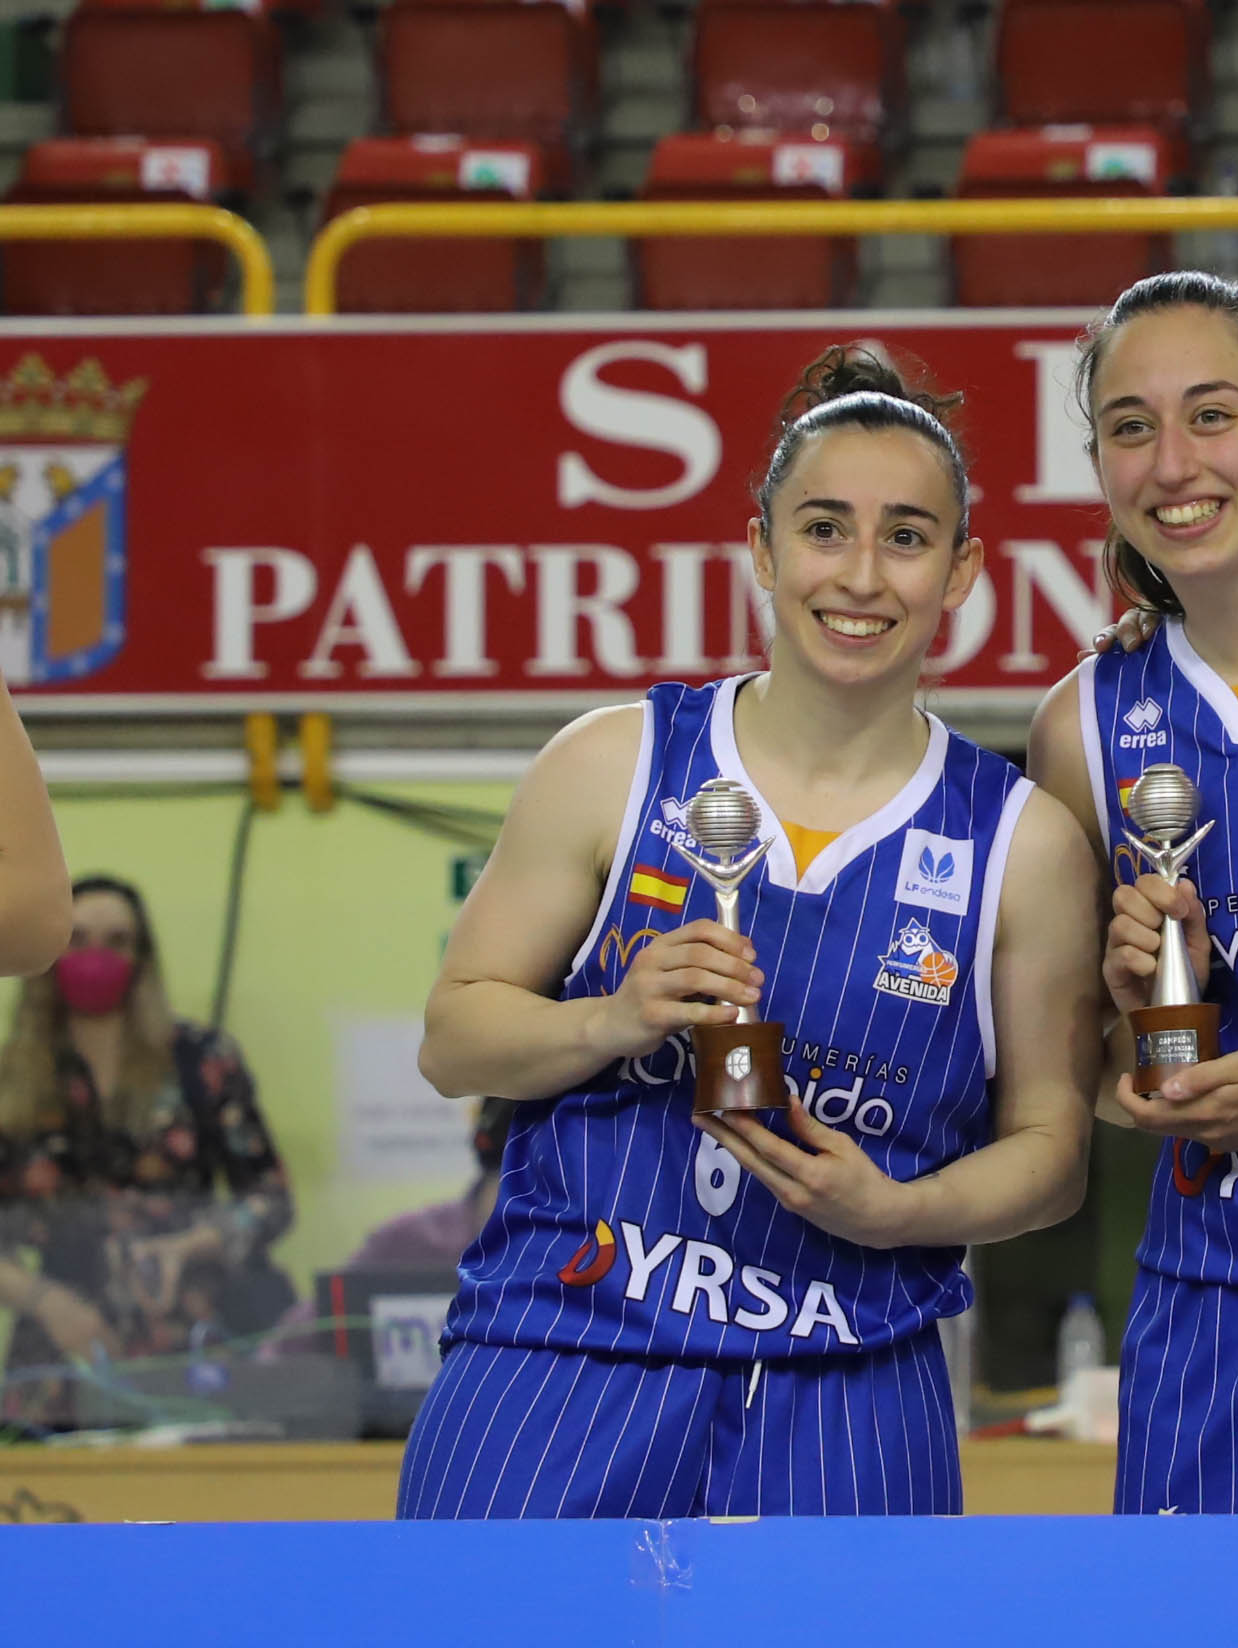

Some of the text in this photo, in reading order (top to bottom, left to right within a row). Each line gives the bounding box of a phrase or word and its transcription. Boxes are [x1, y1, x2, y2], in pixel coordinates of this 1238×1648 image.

[904, 881, 961, 903] LF endesa
[878, 972, 948, 1002] AVENIDA
[780, 1037, 909, 1084] UMERÍAS
[695, 1112, 742, 1217] 6
